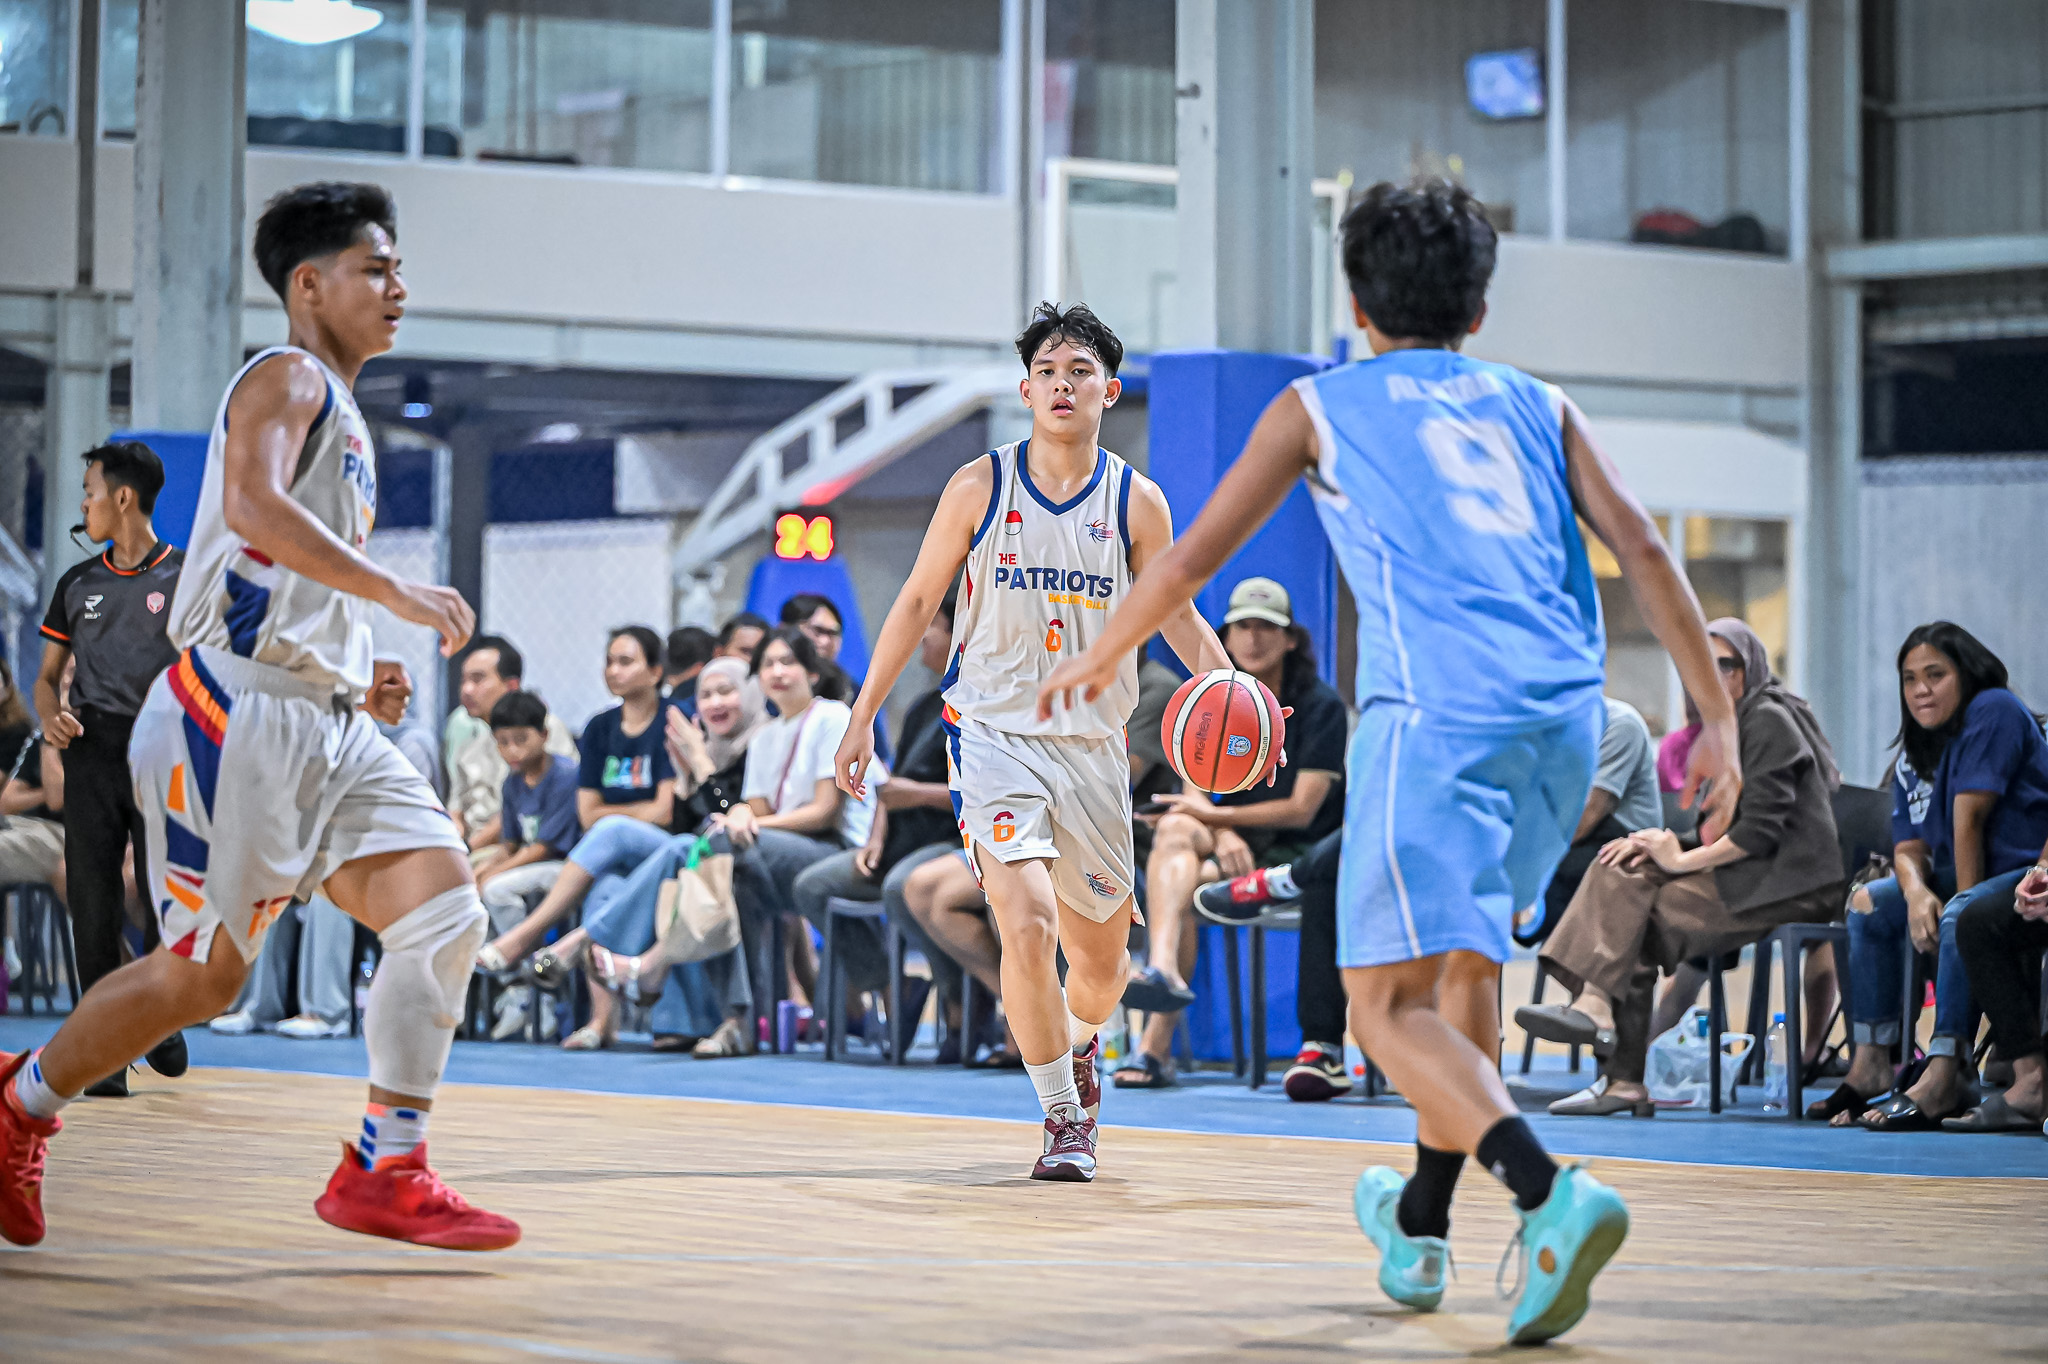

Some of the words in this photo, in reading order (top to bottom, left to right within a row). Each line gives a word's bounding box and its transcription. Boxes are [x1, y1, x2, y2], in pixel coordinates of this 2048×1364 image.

[1415, 417, 1533, 535] 9
[775, 513, 834, 561] 24
[998, 553, 1017, 565] THE
[995, 567, 1115, 599] PATRIOTS
[1045, 619, 1065, 652] 6
[1193, 711, 1213, 766] molten
[993, 810, 1016, 842] 6
